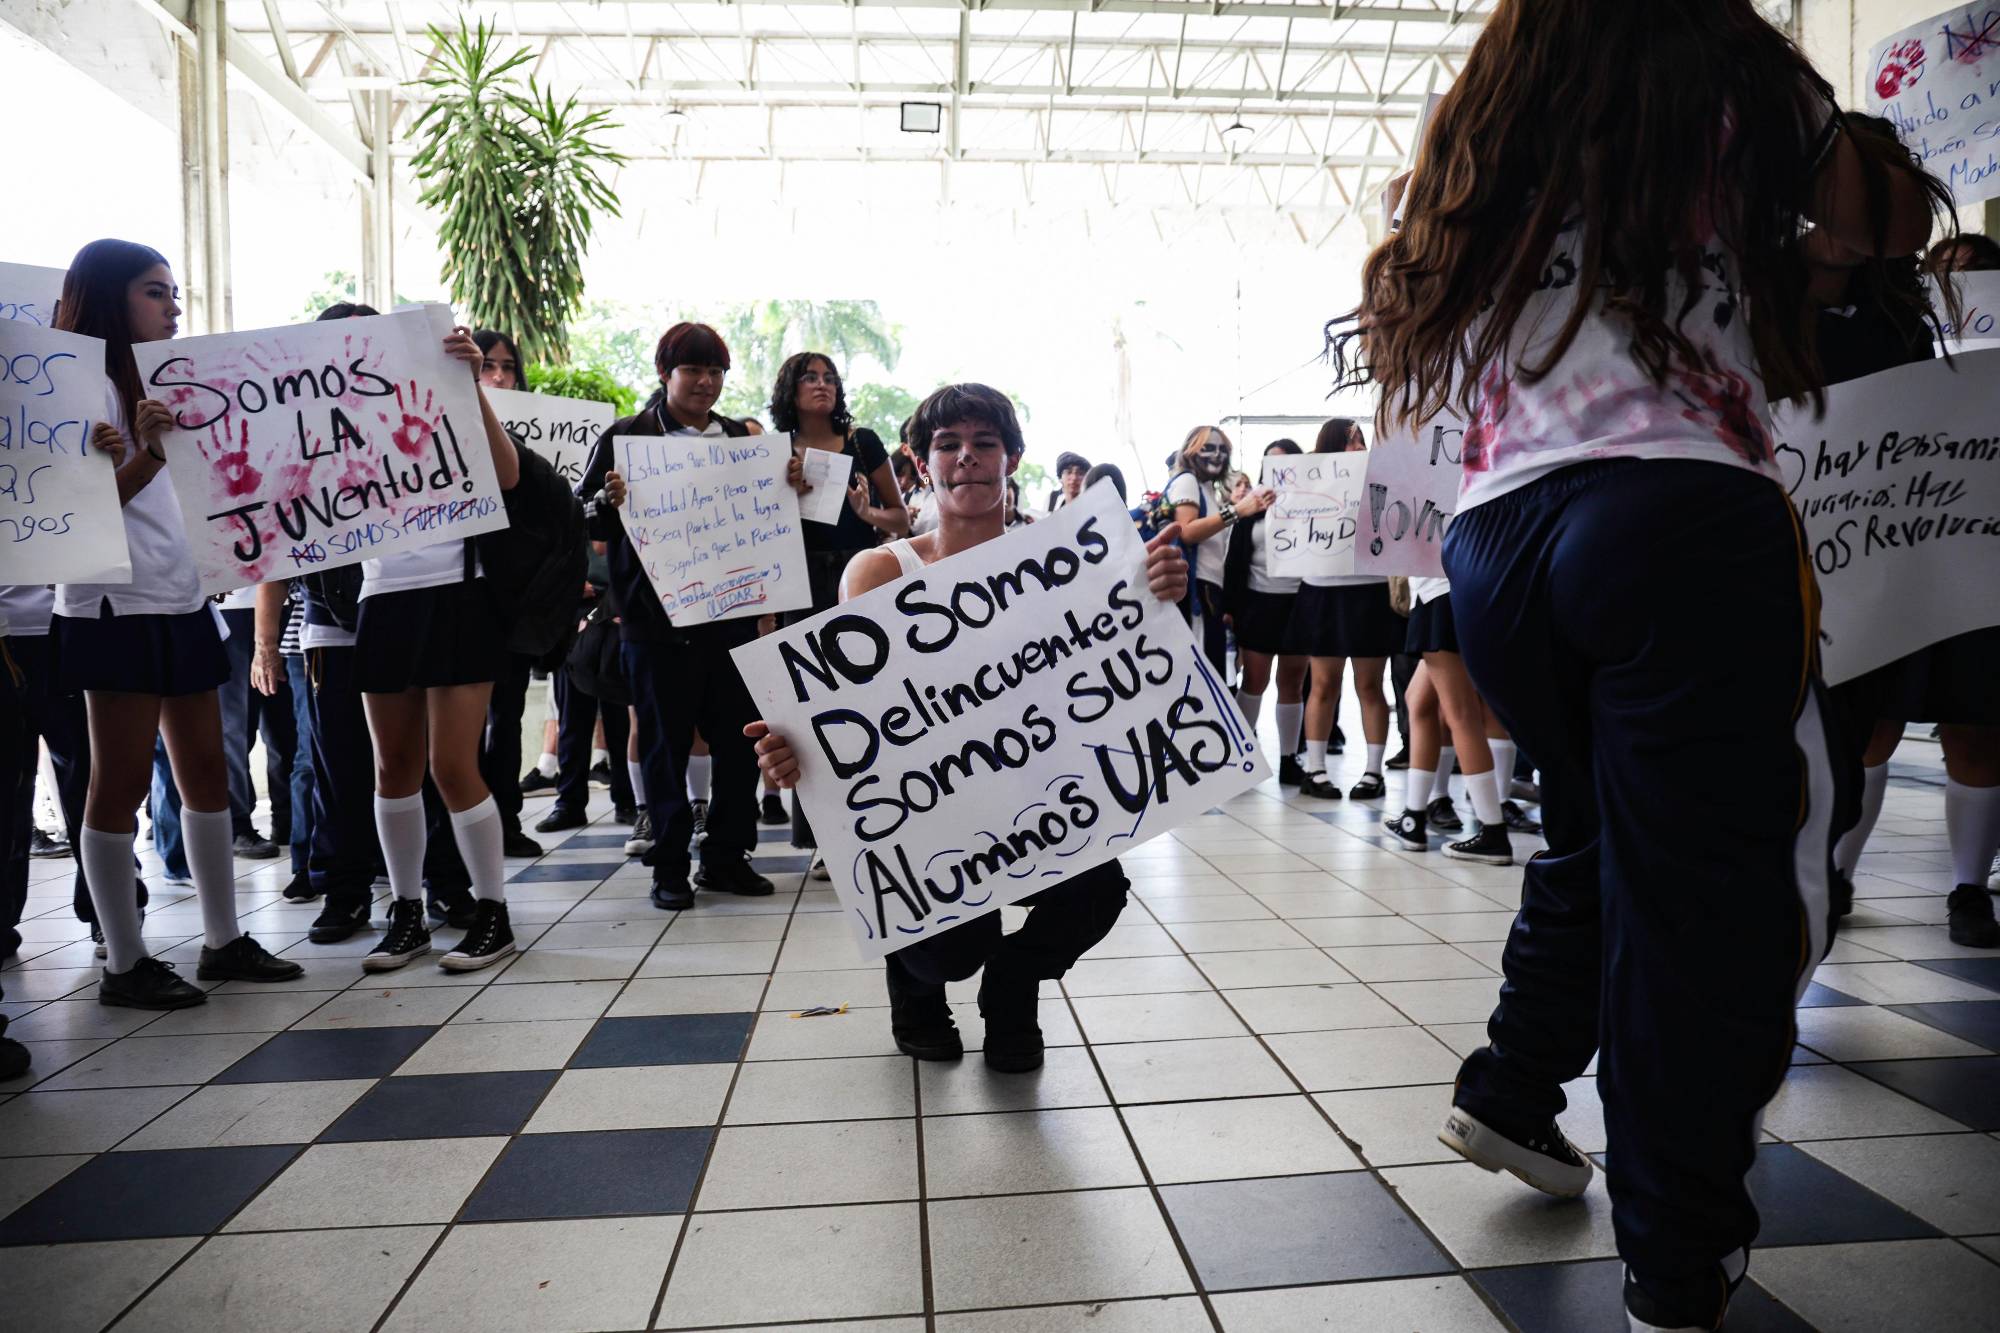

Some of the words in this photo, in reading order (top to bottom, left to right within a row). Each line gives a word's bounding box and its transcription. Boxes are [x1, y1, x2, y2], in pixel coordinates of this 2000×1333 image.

[296, 406, 368, 461] LA
[1308, 467, 1321, 480] a
[1333, 460, 1350, 479] la
[1814, 439, 1870, 481] hay
[777, 614, 890, 703] NO
[810, 579, 1145, 781] Delincuentes
[1065, 634, 1173, 723] SUS
[864, 780, 1100, 940] Alumnos
